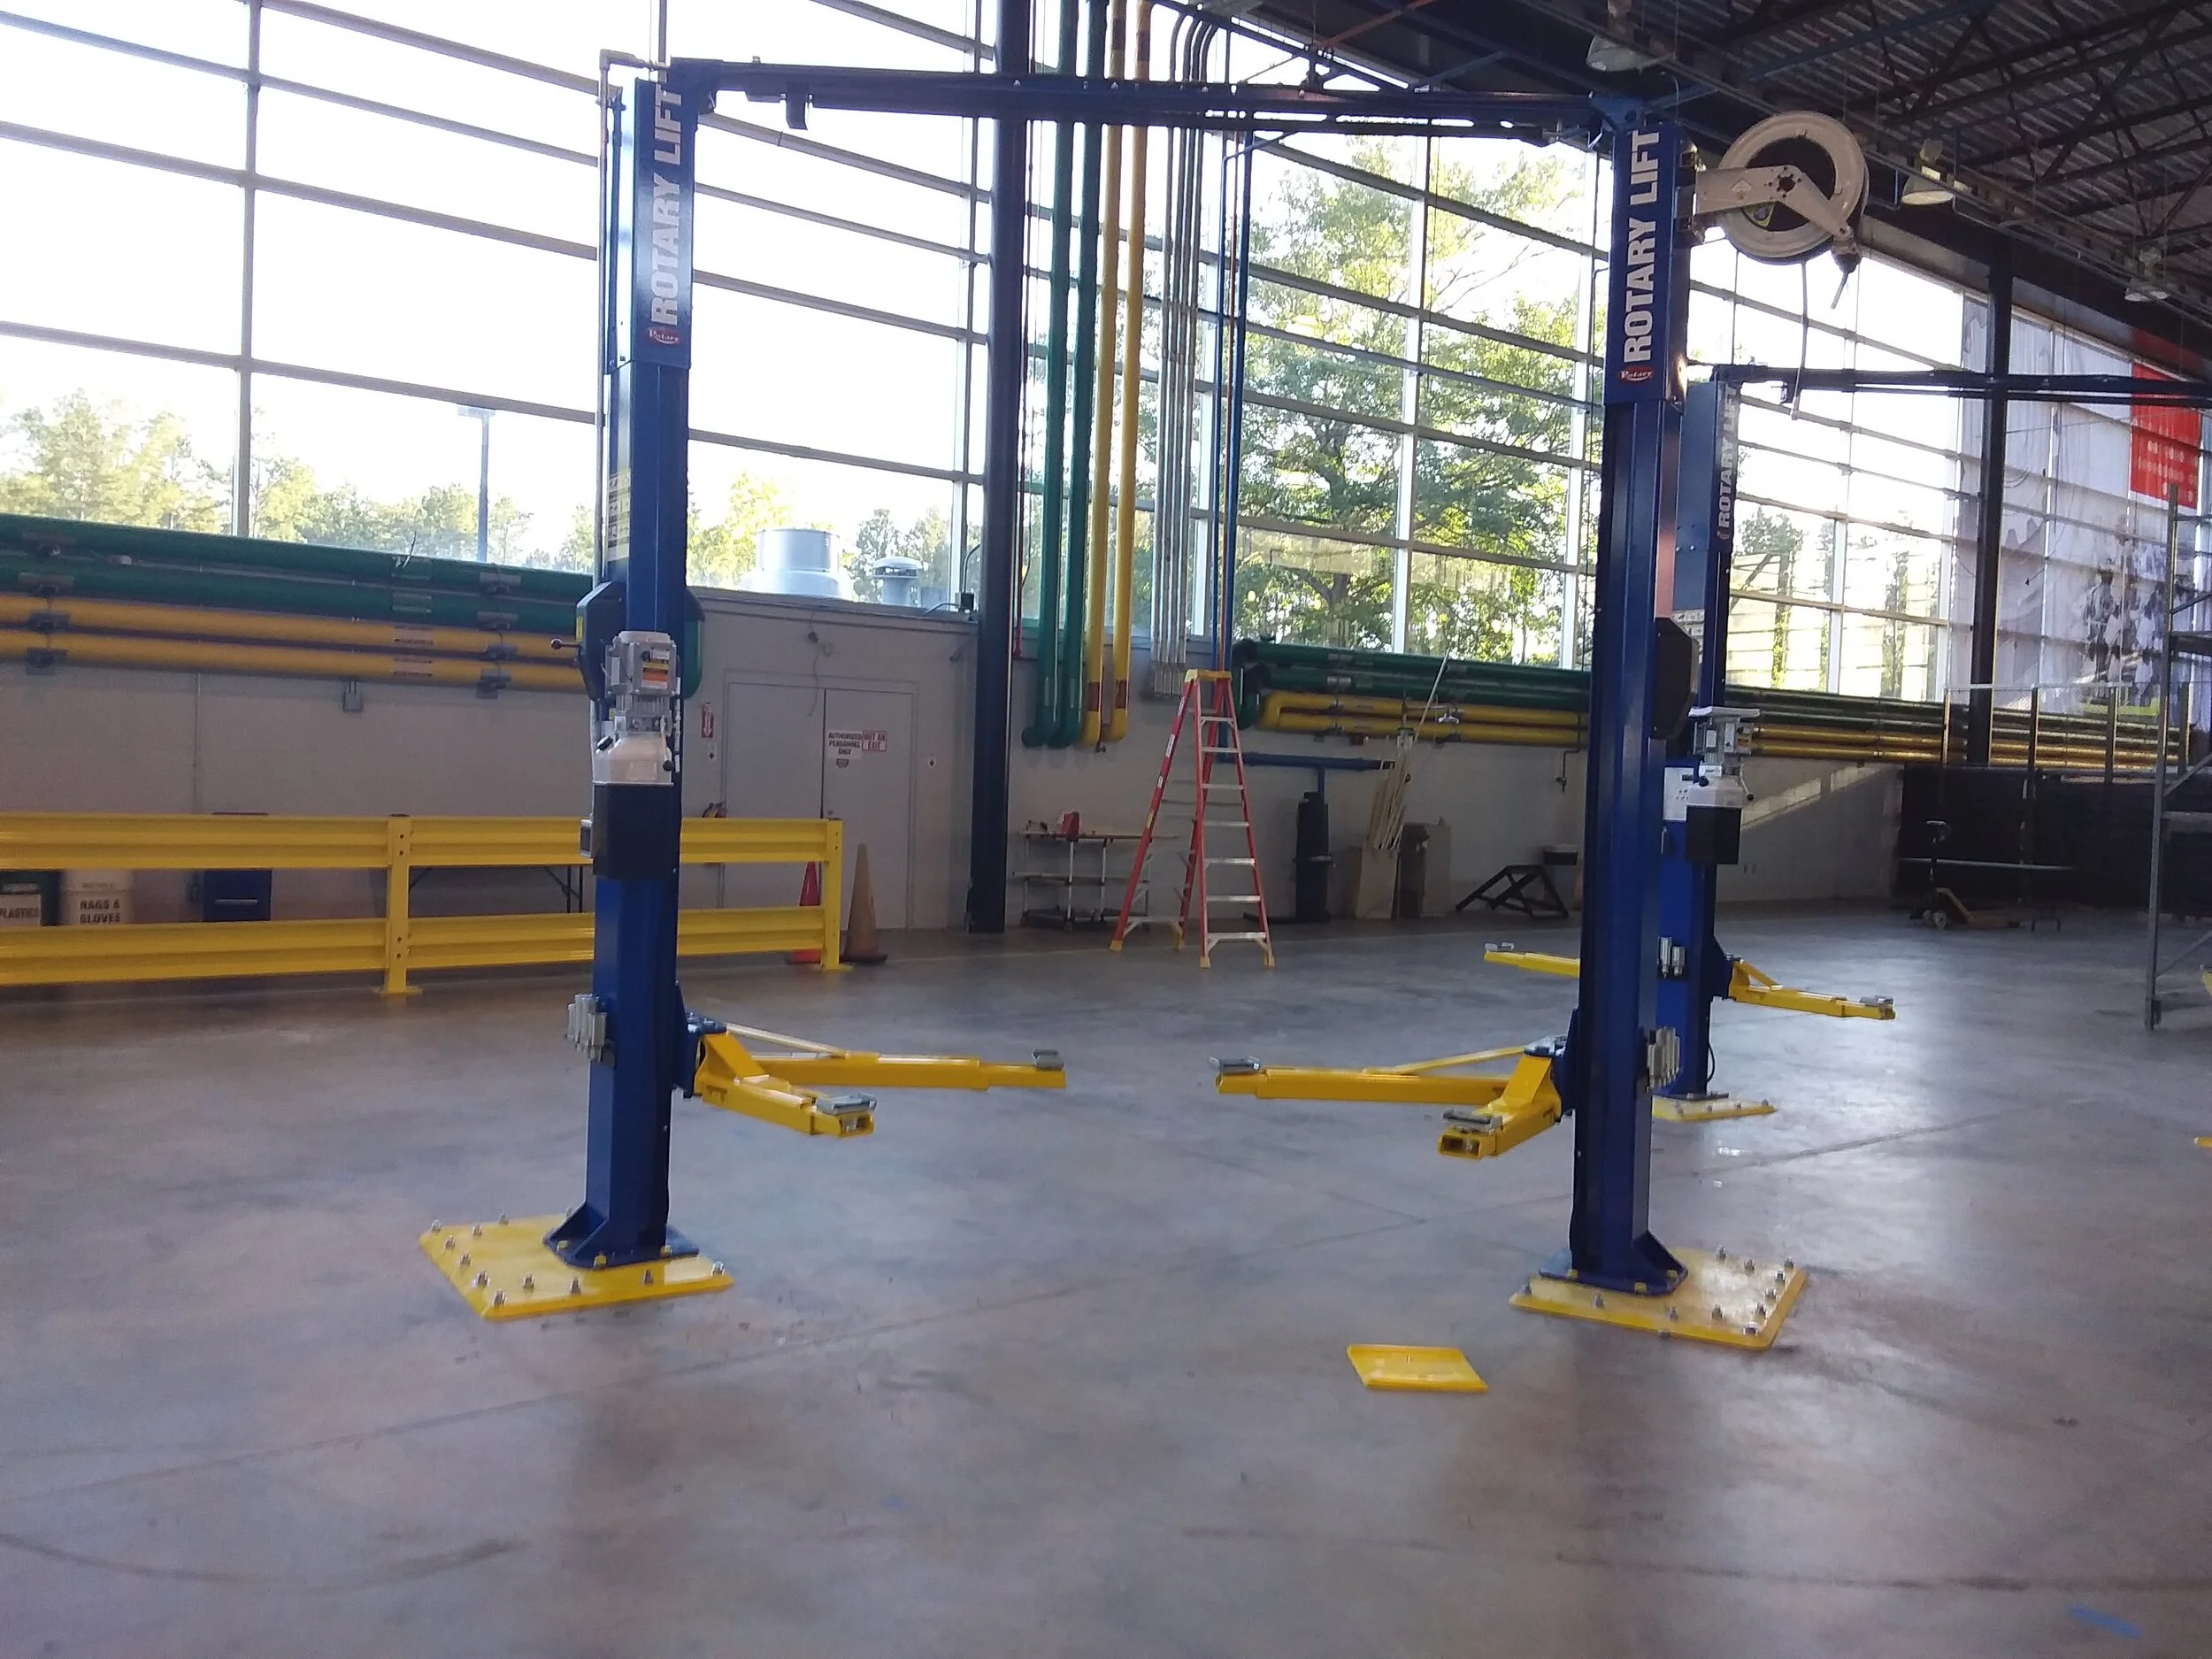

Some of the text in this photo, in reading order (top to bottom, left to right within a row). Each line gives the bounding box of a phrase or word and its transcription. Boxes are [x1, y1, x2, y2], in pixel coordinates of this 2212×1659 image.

[651, 83, 682, 326] ROTARY LIFT
[1624, 130, 1659, 363] ROTARY LIFT
[1620, 370, 1653, 382] Rotary
[1724, 384, 1737, 432] LIFT
[1717, 437, 1735, 528] ROTARY
[80, 899, 111, 910] RAGS
[80, 912, 120, 924] GLOVES
